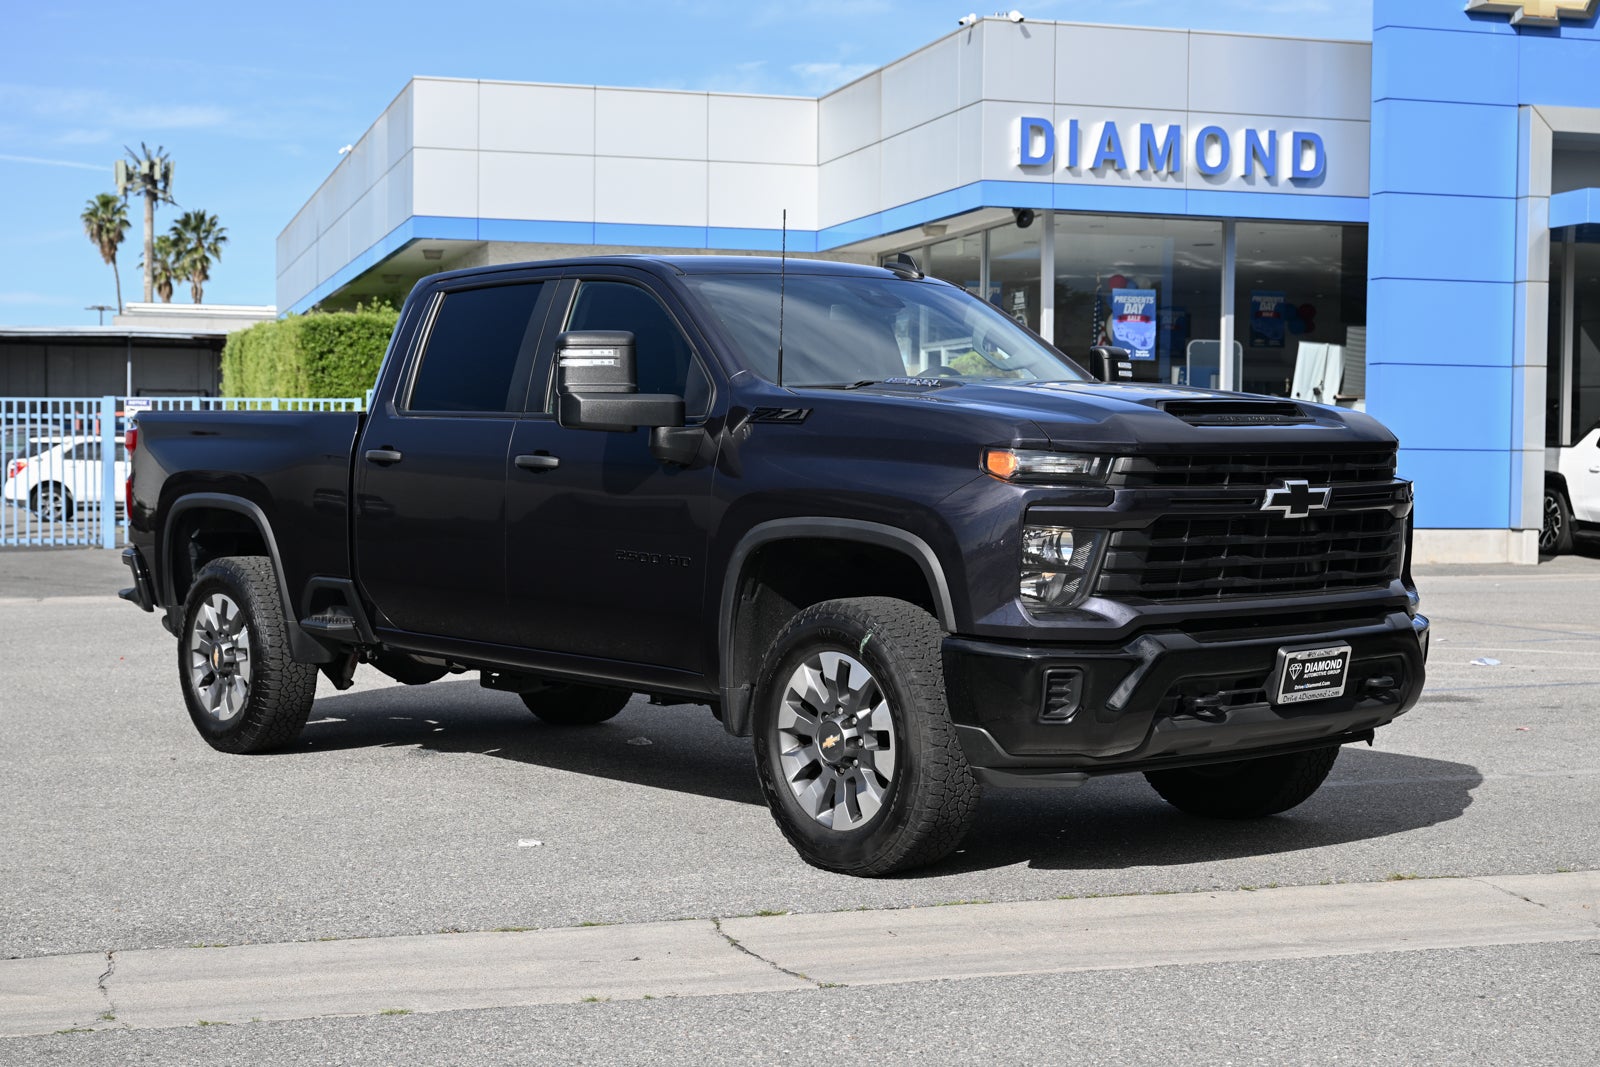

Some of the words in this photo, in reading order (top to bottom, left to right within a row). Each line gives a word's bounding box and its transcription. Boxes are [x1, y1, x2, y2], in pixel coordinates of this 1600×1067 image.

[1020, 116, 1326, 179] DIAMOND
[1114, 295, 1154, 304] PRESIDENTS
[1123, 303, 1145, 314] DAY
[1305, 659, 1342, 673] DIAMOND
